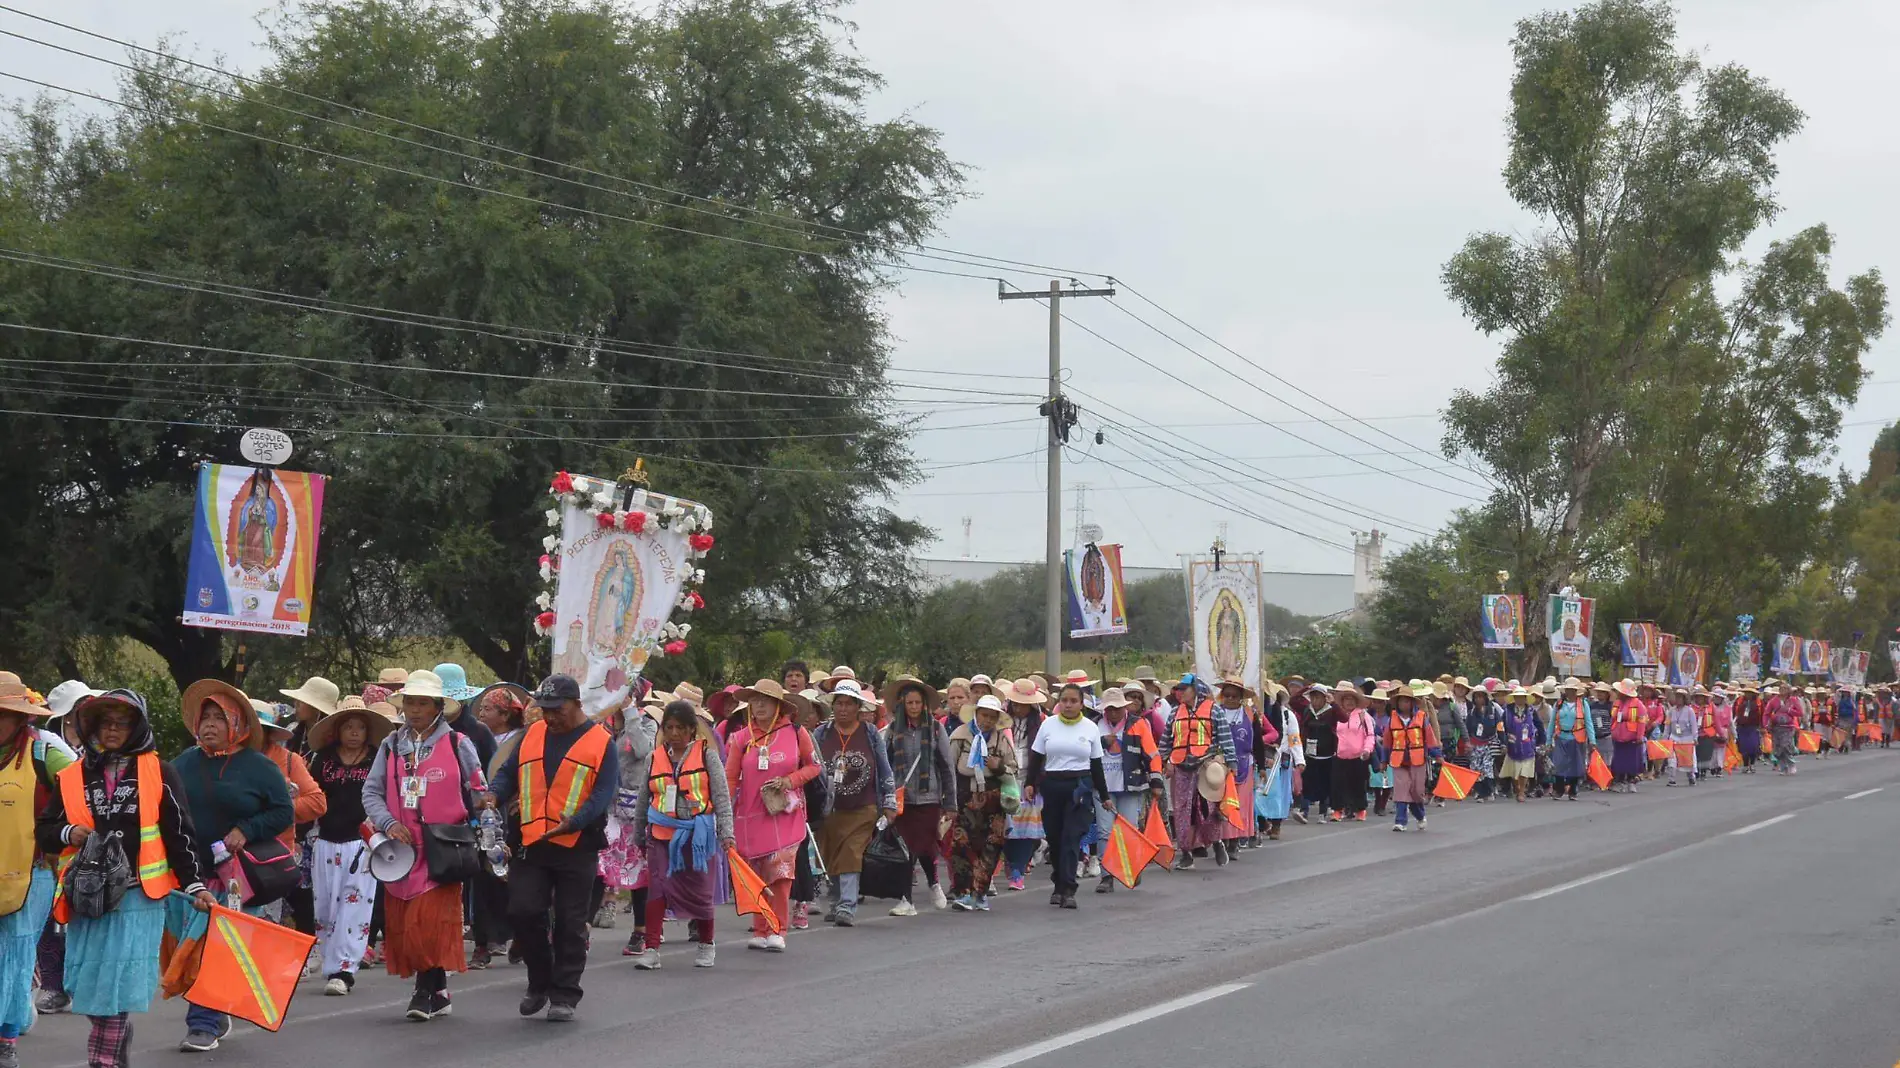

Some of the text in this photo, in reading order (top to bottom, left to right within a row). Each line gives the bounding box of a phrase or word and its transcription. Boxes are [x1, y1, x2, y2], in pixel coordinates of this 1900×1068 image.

[248, 431, 289, 443] EZEQUIEL
[252, 440, 285, 451] MONTES
[254, 448, 273, 461] 95
[647, 538, 676, 584] TEPEYAC
[1565, 602, 1578, 614] 97
[269, 621, 291, 631] 2018
